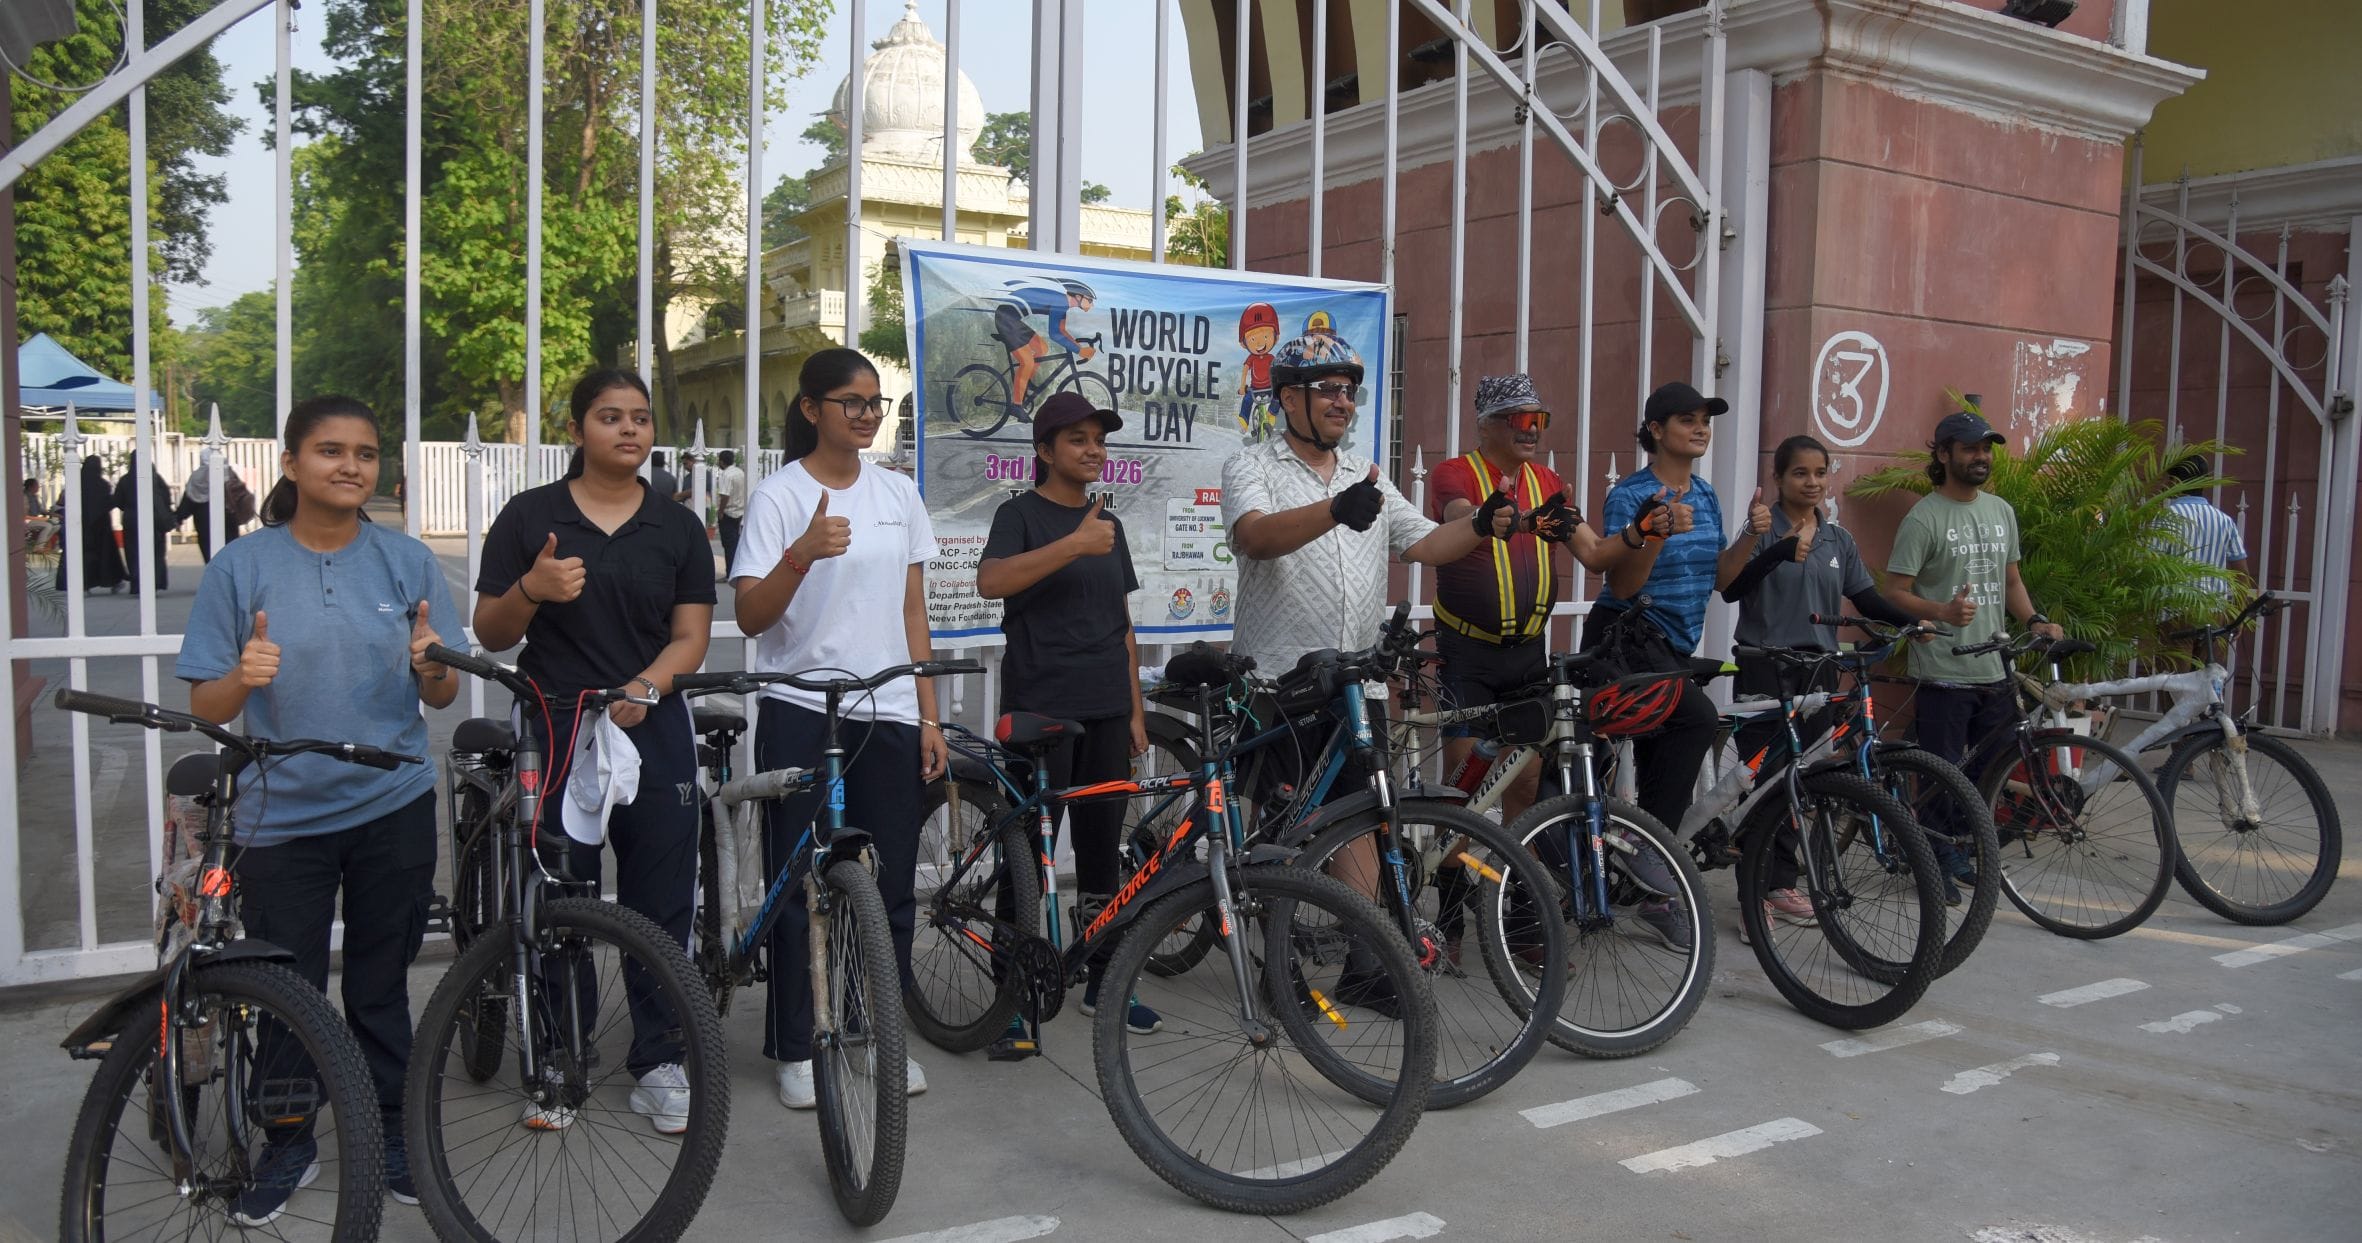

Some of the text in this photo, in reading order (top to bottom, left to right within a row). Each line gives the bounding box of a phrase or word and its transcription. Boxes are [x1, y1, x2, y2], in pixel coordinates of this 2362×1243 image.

[1110, 307, 1210, 355] WORLD
[1107, 353, 1221, 400] BICYCLE
[1826, 351, 1874, 429] 3
[1144, 401, 1198, 443] DAY
[985, 454, 1025, 481] 3rd
[1095, 459, 1143, 484] 026
[1202, 492, 1221, 503] RAL
[1175, 523, 1188, 532] GATE
[1199, 523, 1204, 533] 3
[934, 536, 975, 546] rganised
[1172, 551, 1204, 560] RAJBHAWAN
[929, 591, 975, 600] Department
[929, 602, 952, 611] Uttar
[953, 601, 982, 611] Pradesh
[928, 614, 956, 623] Neeva
[958, 612, 999, 622] Foundation,
